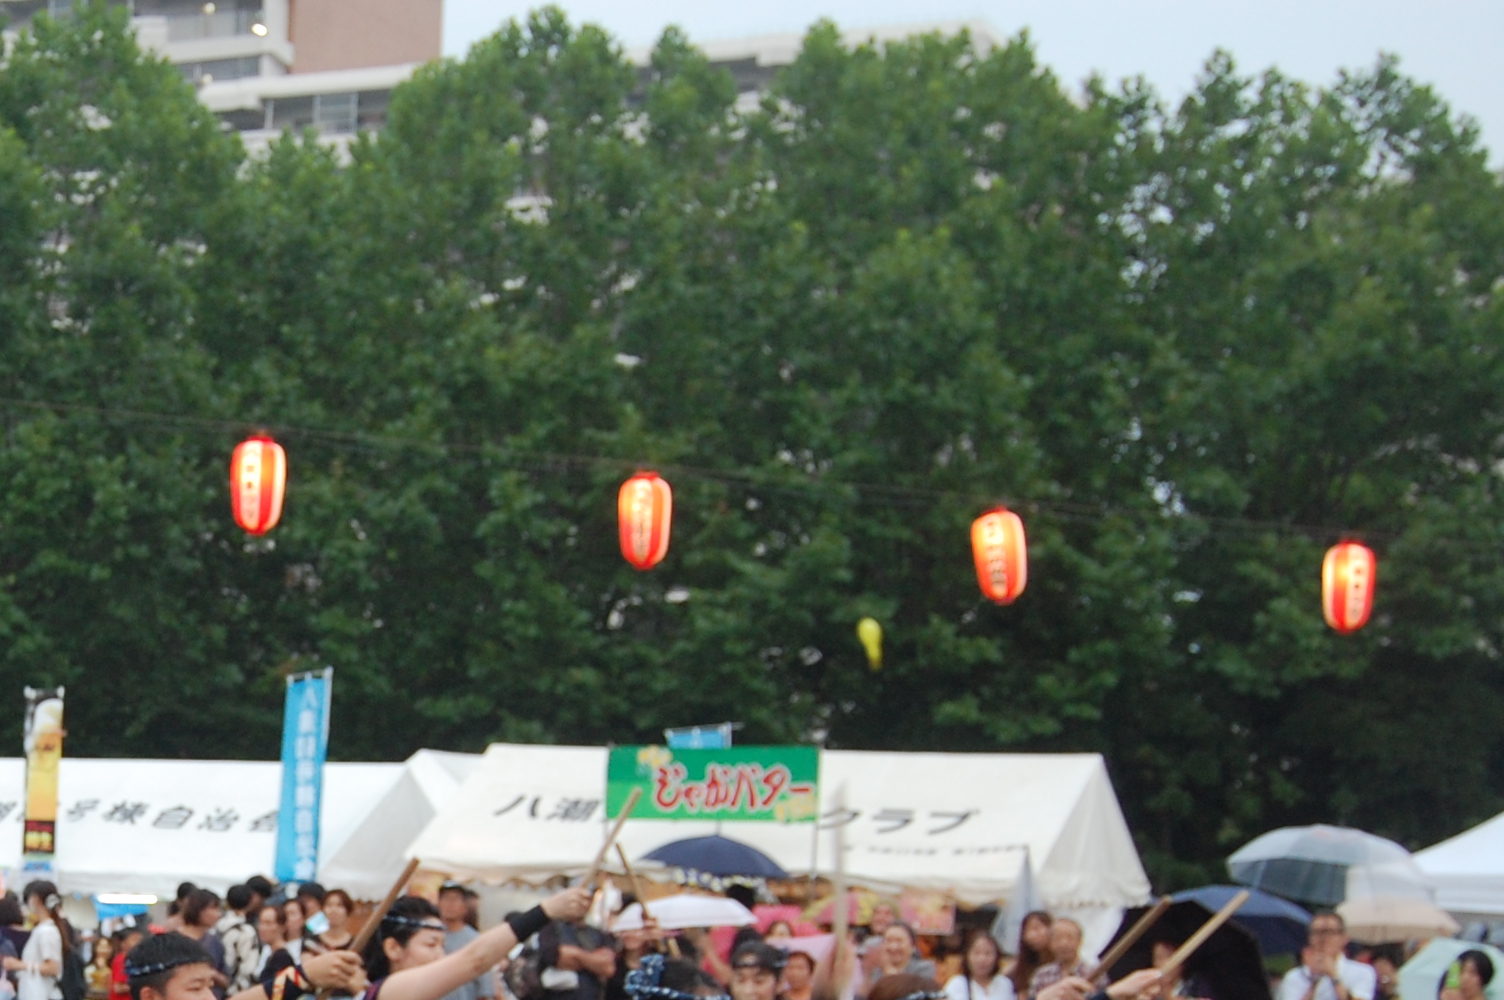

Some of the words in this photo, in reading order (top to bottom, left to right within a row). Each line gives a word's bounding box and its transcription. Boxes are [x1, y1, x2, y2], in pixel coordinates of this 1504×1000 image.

[655, 763, 813, 810] じゃがバター
